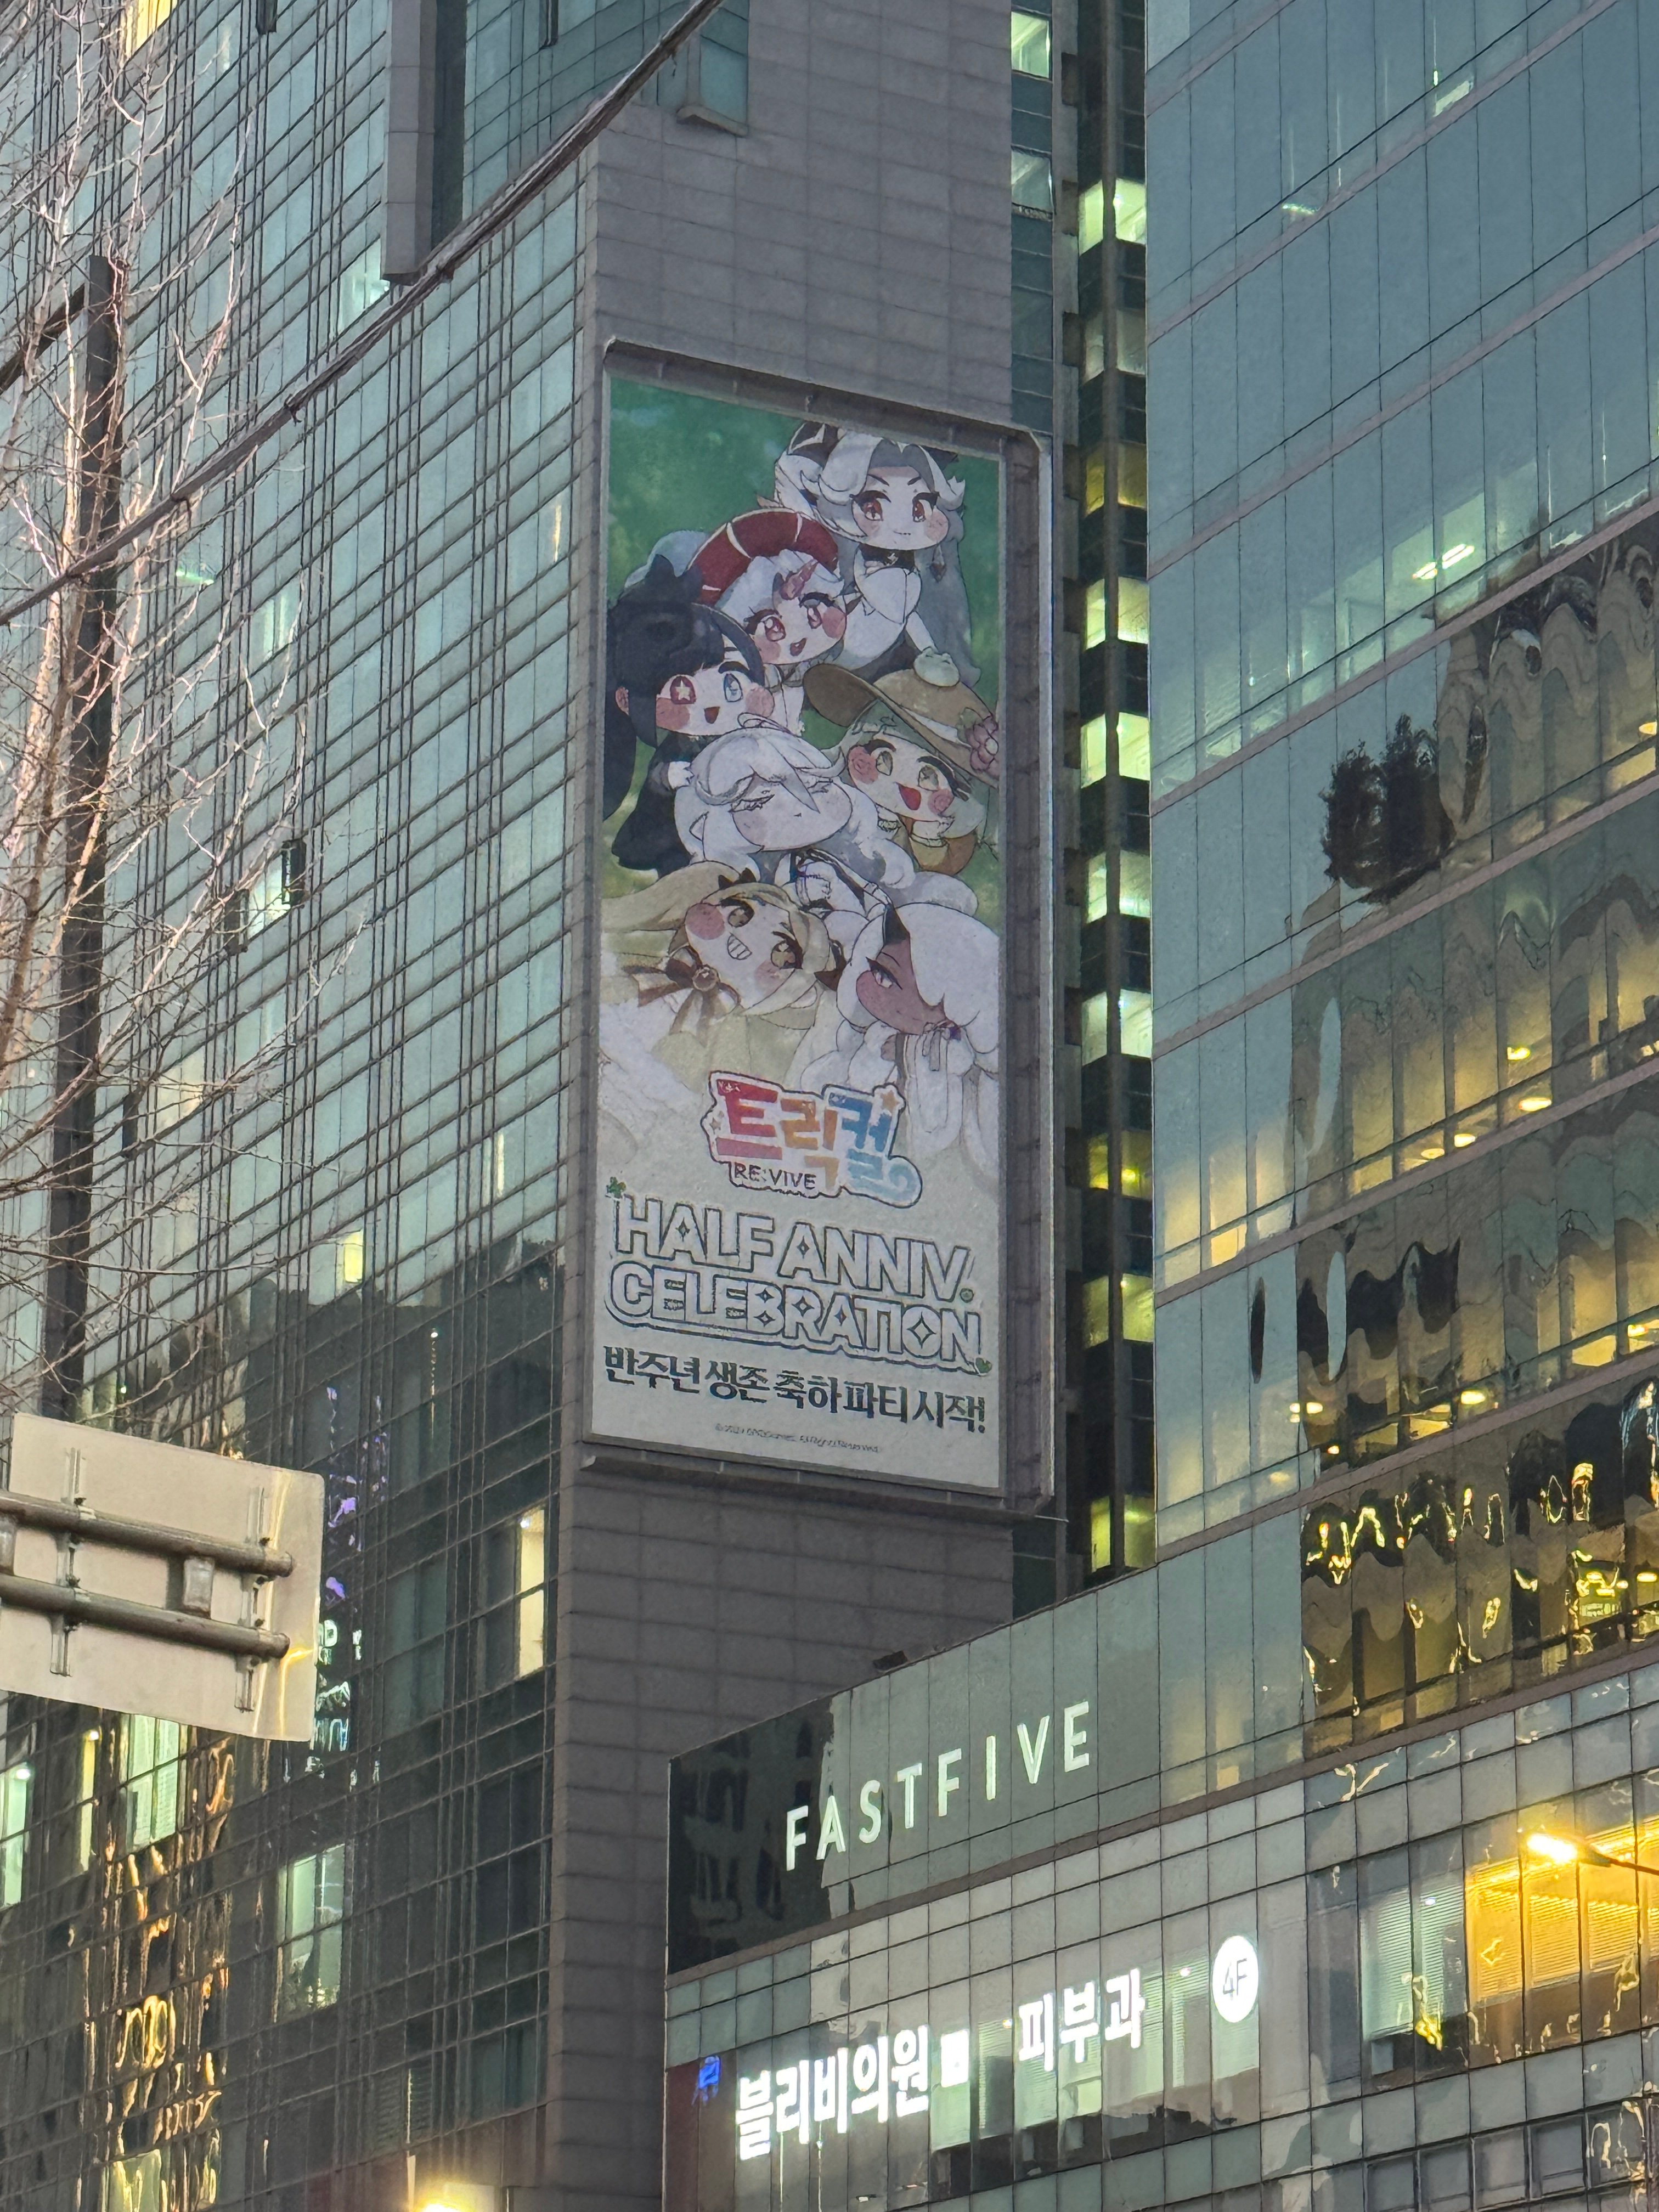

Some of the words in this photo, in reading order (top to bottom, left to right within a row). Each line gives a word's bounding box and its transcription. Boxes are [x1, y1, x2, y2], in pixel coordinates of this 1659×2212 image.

[716, 1079, 918, 1201] 트릭컬
[614, 1193, 775, 1273] HALF
[777, 1222, 974, 1303] ANNIV.
[610, 1261, 982, 1365] CELEBRATION
[603, 1346, 701, 1394] 반주년
[705, 1360, 770, 1403] 생존
[912, 1390, 986, 1434] 시작!
[786, 1701, 1090, 1872] FASTFIVE
[736, 2024, 929, 2161] 블리비의원
[1018, 1967, 1146, 2072] 피부과
[1223, 1957, 1248, 2001] 4F
